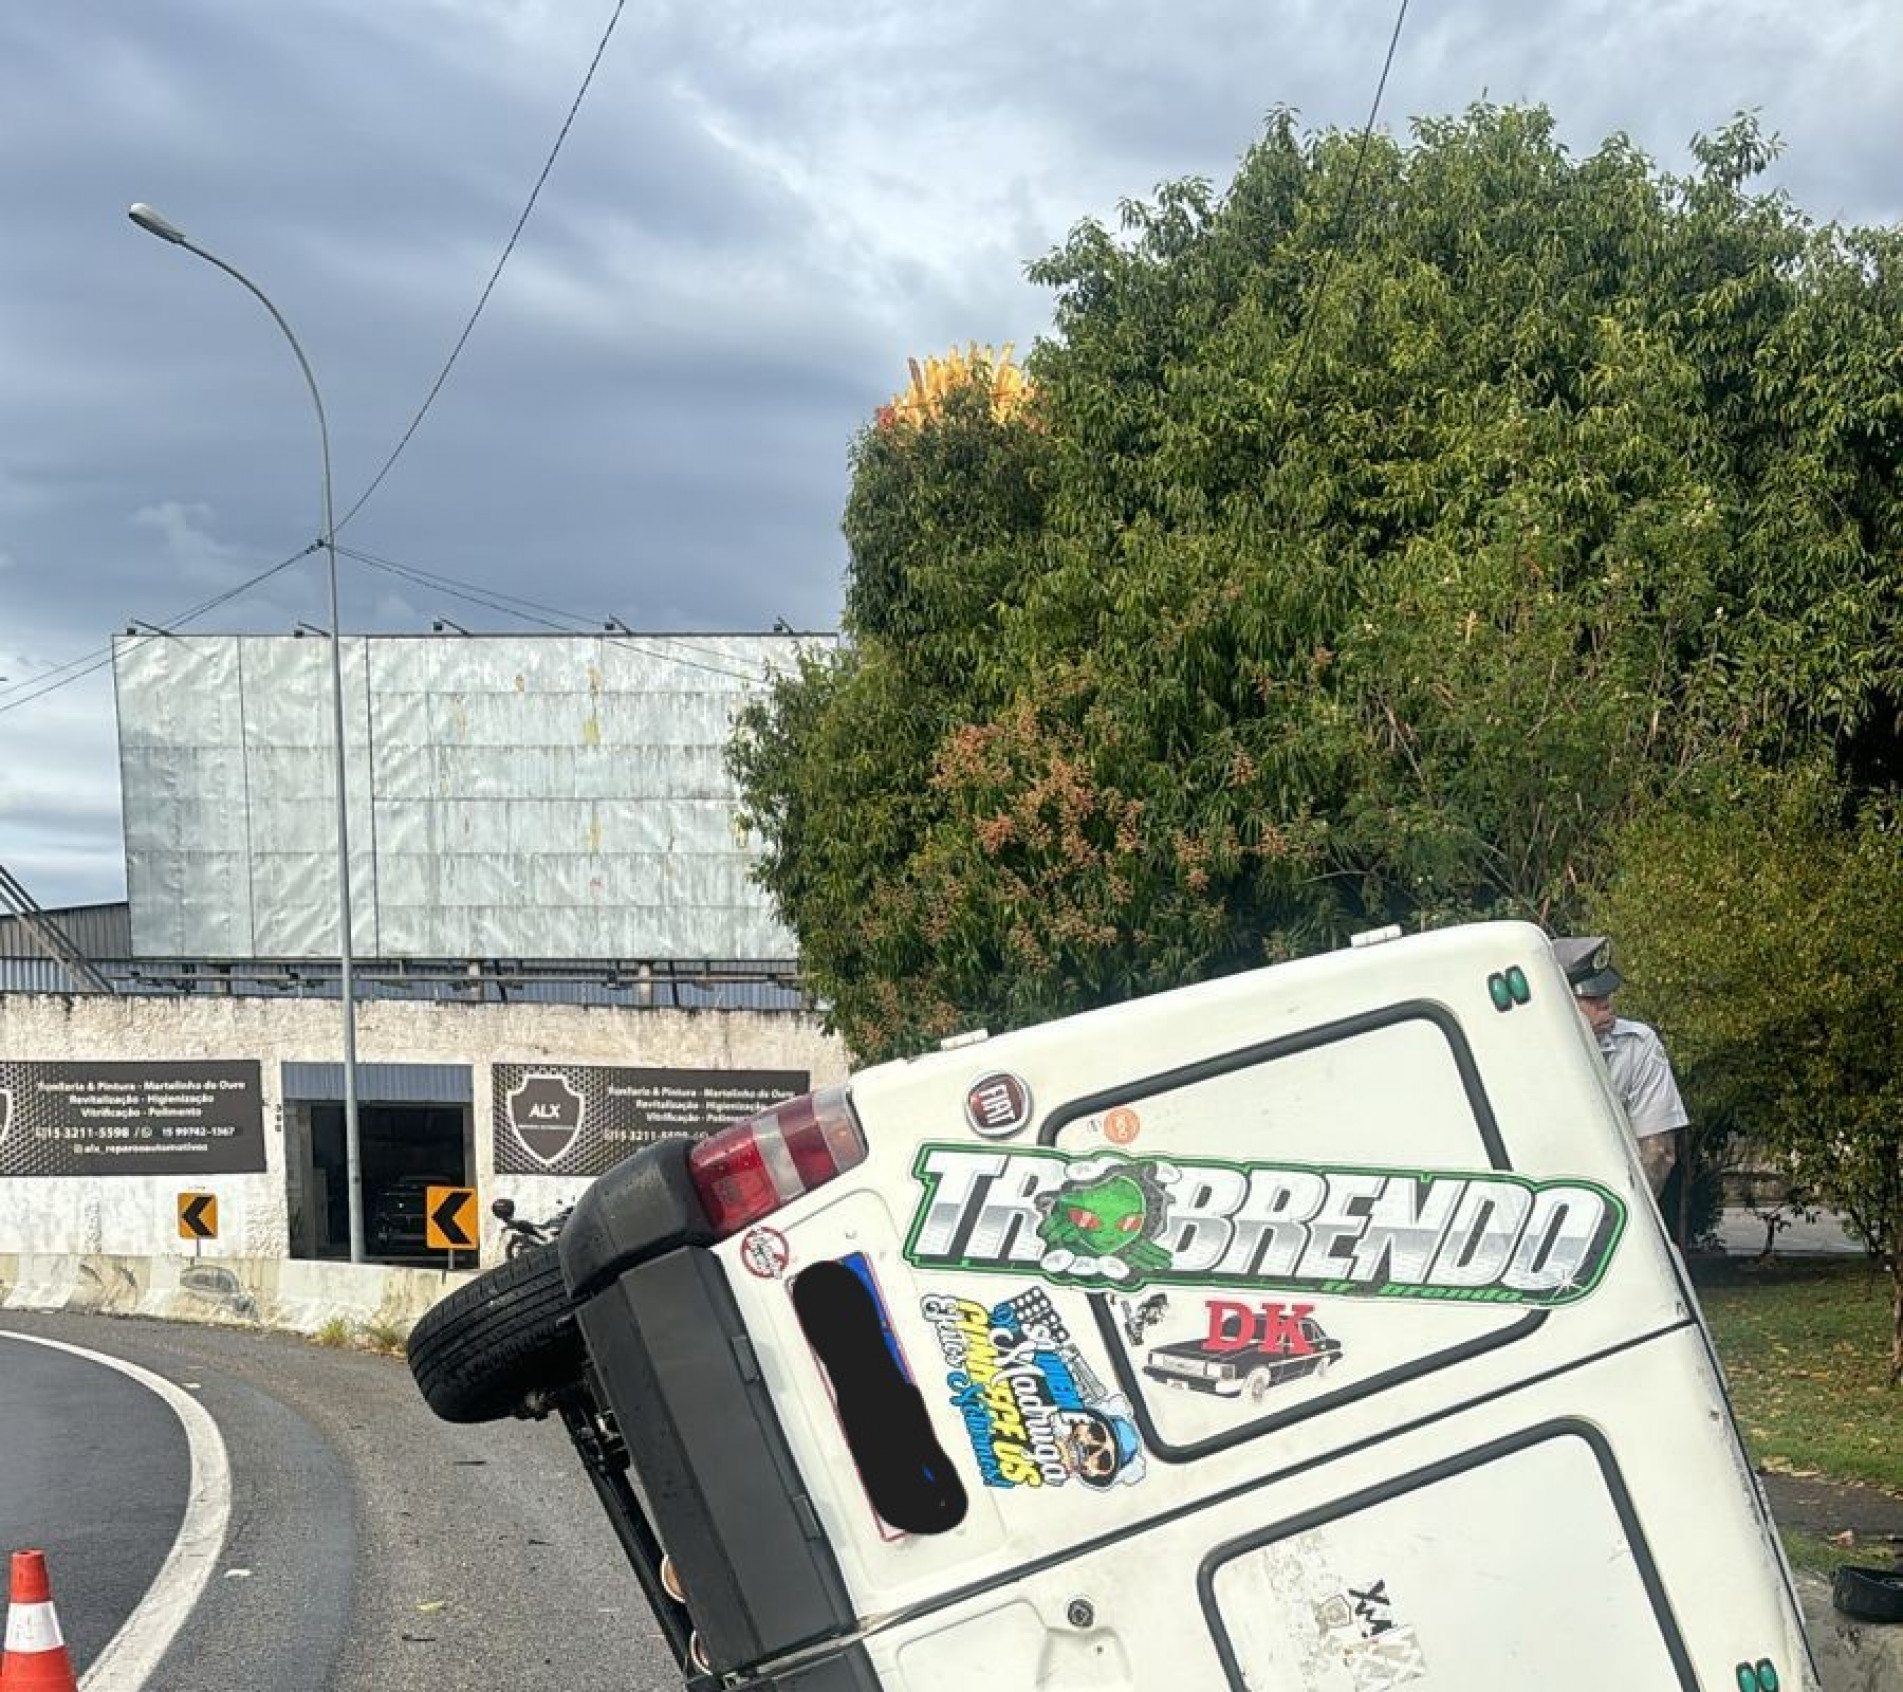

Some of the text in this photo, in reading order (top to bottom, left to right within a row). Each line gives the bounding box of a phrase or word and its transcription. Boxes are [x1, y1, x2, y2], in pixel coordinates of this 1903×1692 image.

[97, 1082, 136, 1091] Pintura
[144, 1081, 201, 1090] Martelinho
[204, 1081, 216, 1090] de
[661, 1087, 697, 1097] Pintura
[703, 1087, 756, 1098] Martelinho
[528, 1103, 561, 1118] ALX
[976, 1083, 1017, 1124] FIAT
[1160, 1166, 1607, 1290] BRENDO
[1202, 1300, 1316, 1355] DK
